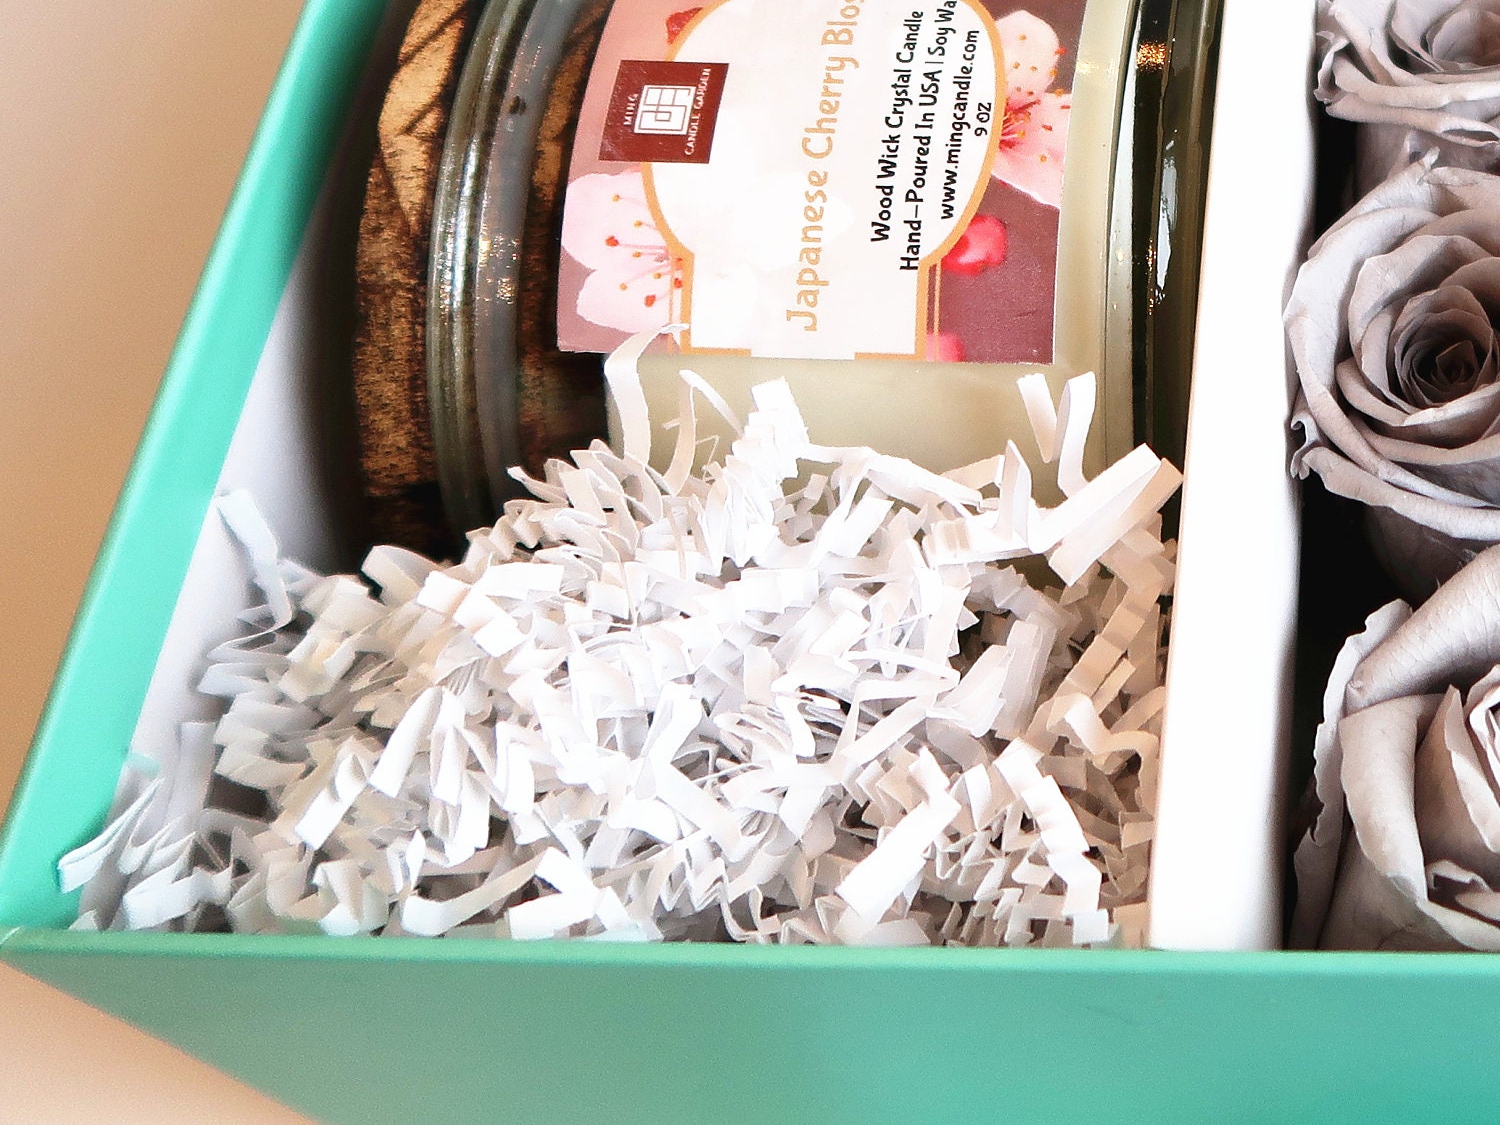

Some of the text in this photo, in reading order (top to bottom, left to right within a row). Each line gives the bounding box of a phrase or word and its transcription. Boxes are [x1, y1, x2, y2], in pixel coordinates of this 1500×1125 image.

[927, 27, 957, 56] Soy
[623, 93, 639, 125] MING
[684, 68, 712, 155] CANDLE GARDEN
[801, 56, 859, 159] Cherry
[918, 69, 943, 107] USA
[870, 10, 924, 242] Wood Wick Crystal Candle
[914, 112, 935, 129] In
[940, 30, 980, 220] www.mingcandle.com
[974, 102, 992, 137] 9 OZ
[786, 170, 829, 332] Japanese
